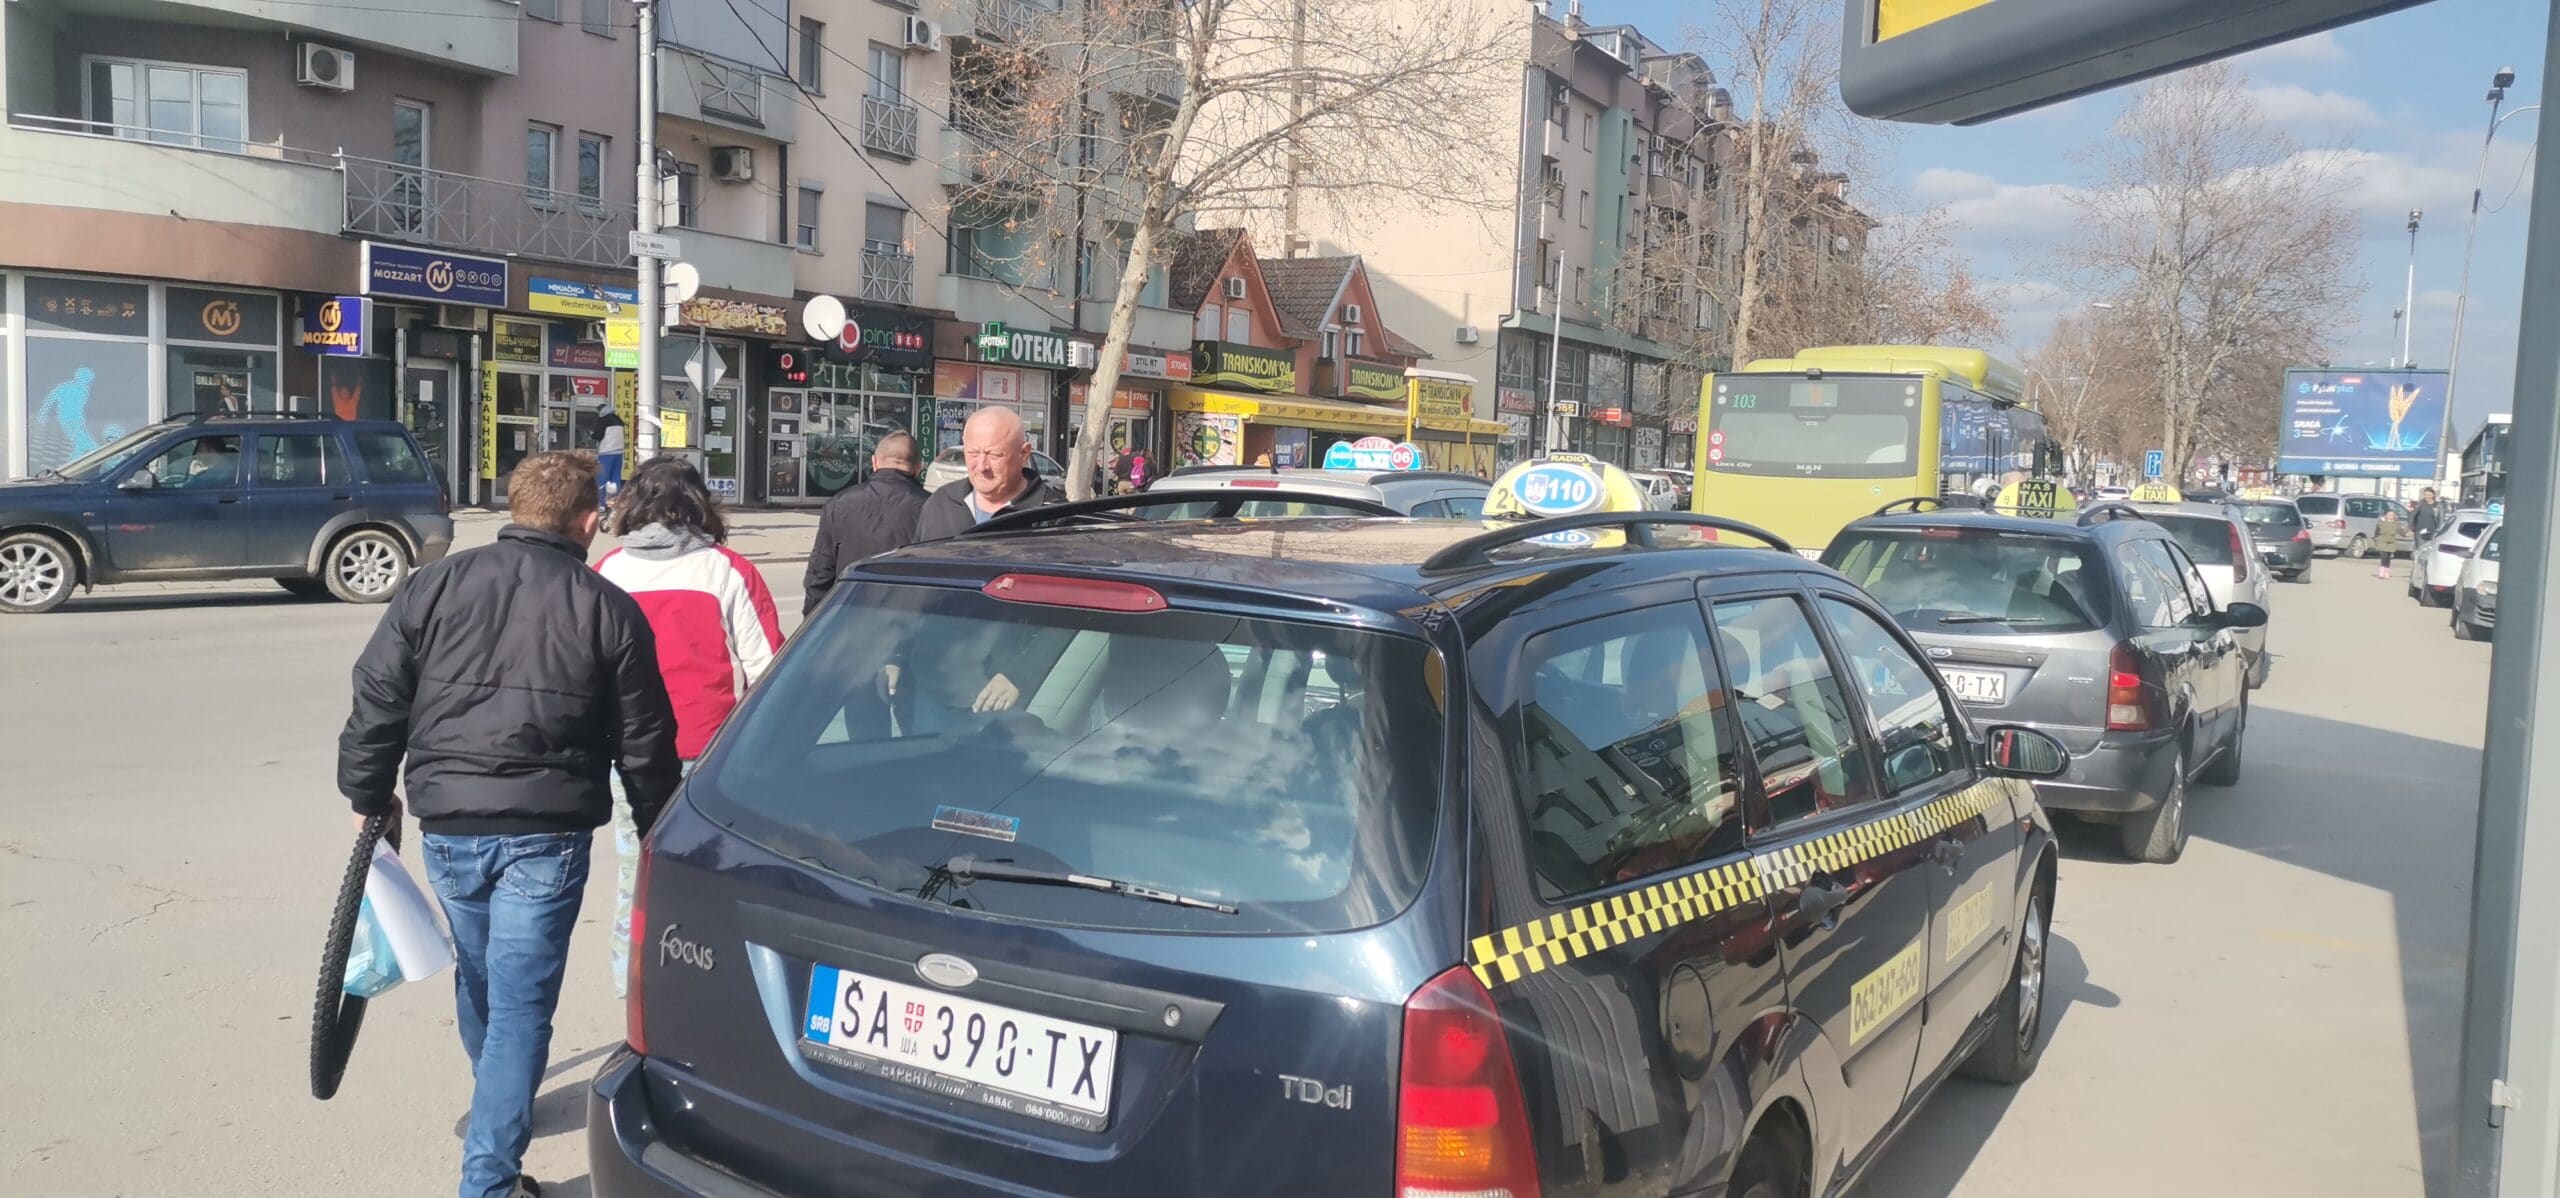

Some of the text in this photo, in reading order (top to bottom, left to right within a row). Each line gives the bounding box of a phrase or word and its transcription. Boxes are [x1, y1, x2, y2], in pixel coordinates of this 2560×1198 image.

[374, 269, 422, 283] MOZZART
[304, 332, 358, 346] MOZZART
[979, 335, 1008, 347] APOTEKA
[1170, 360, 1188, 370] STIHL
[1222, 352, 1292, 377] TRANSKOM'94
[1132, 393, 1149, 401] STIHL
[1732, 394, 1756, 408] 103
[482, 369, 492, 470] МЕЊАЧНИЦА
[1392, 452, 1410, 463] 06
[1550, 454, 1585, 463] RADIO
[1711, 450, 1720, 459] 50
[1549, 478, 1586, 502] 110
[2022, 482, 2052, 491] NAŠ
[2020, 490, 2053, 508] TAXI
[2145, 490, 2168, 501] TAXI
[840, 977, 889, 1049] ŠA
[810, 1014, 830, 1033] SRB
[1278, 1073, 1352, 1110] TDdi
